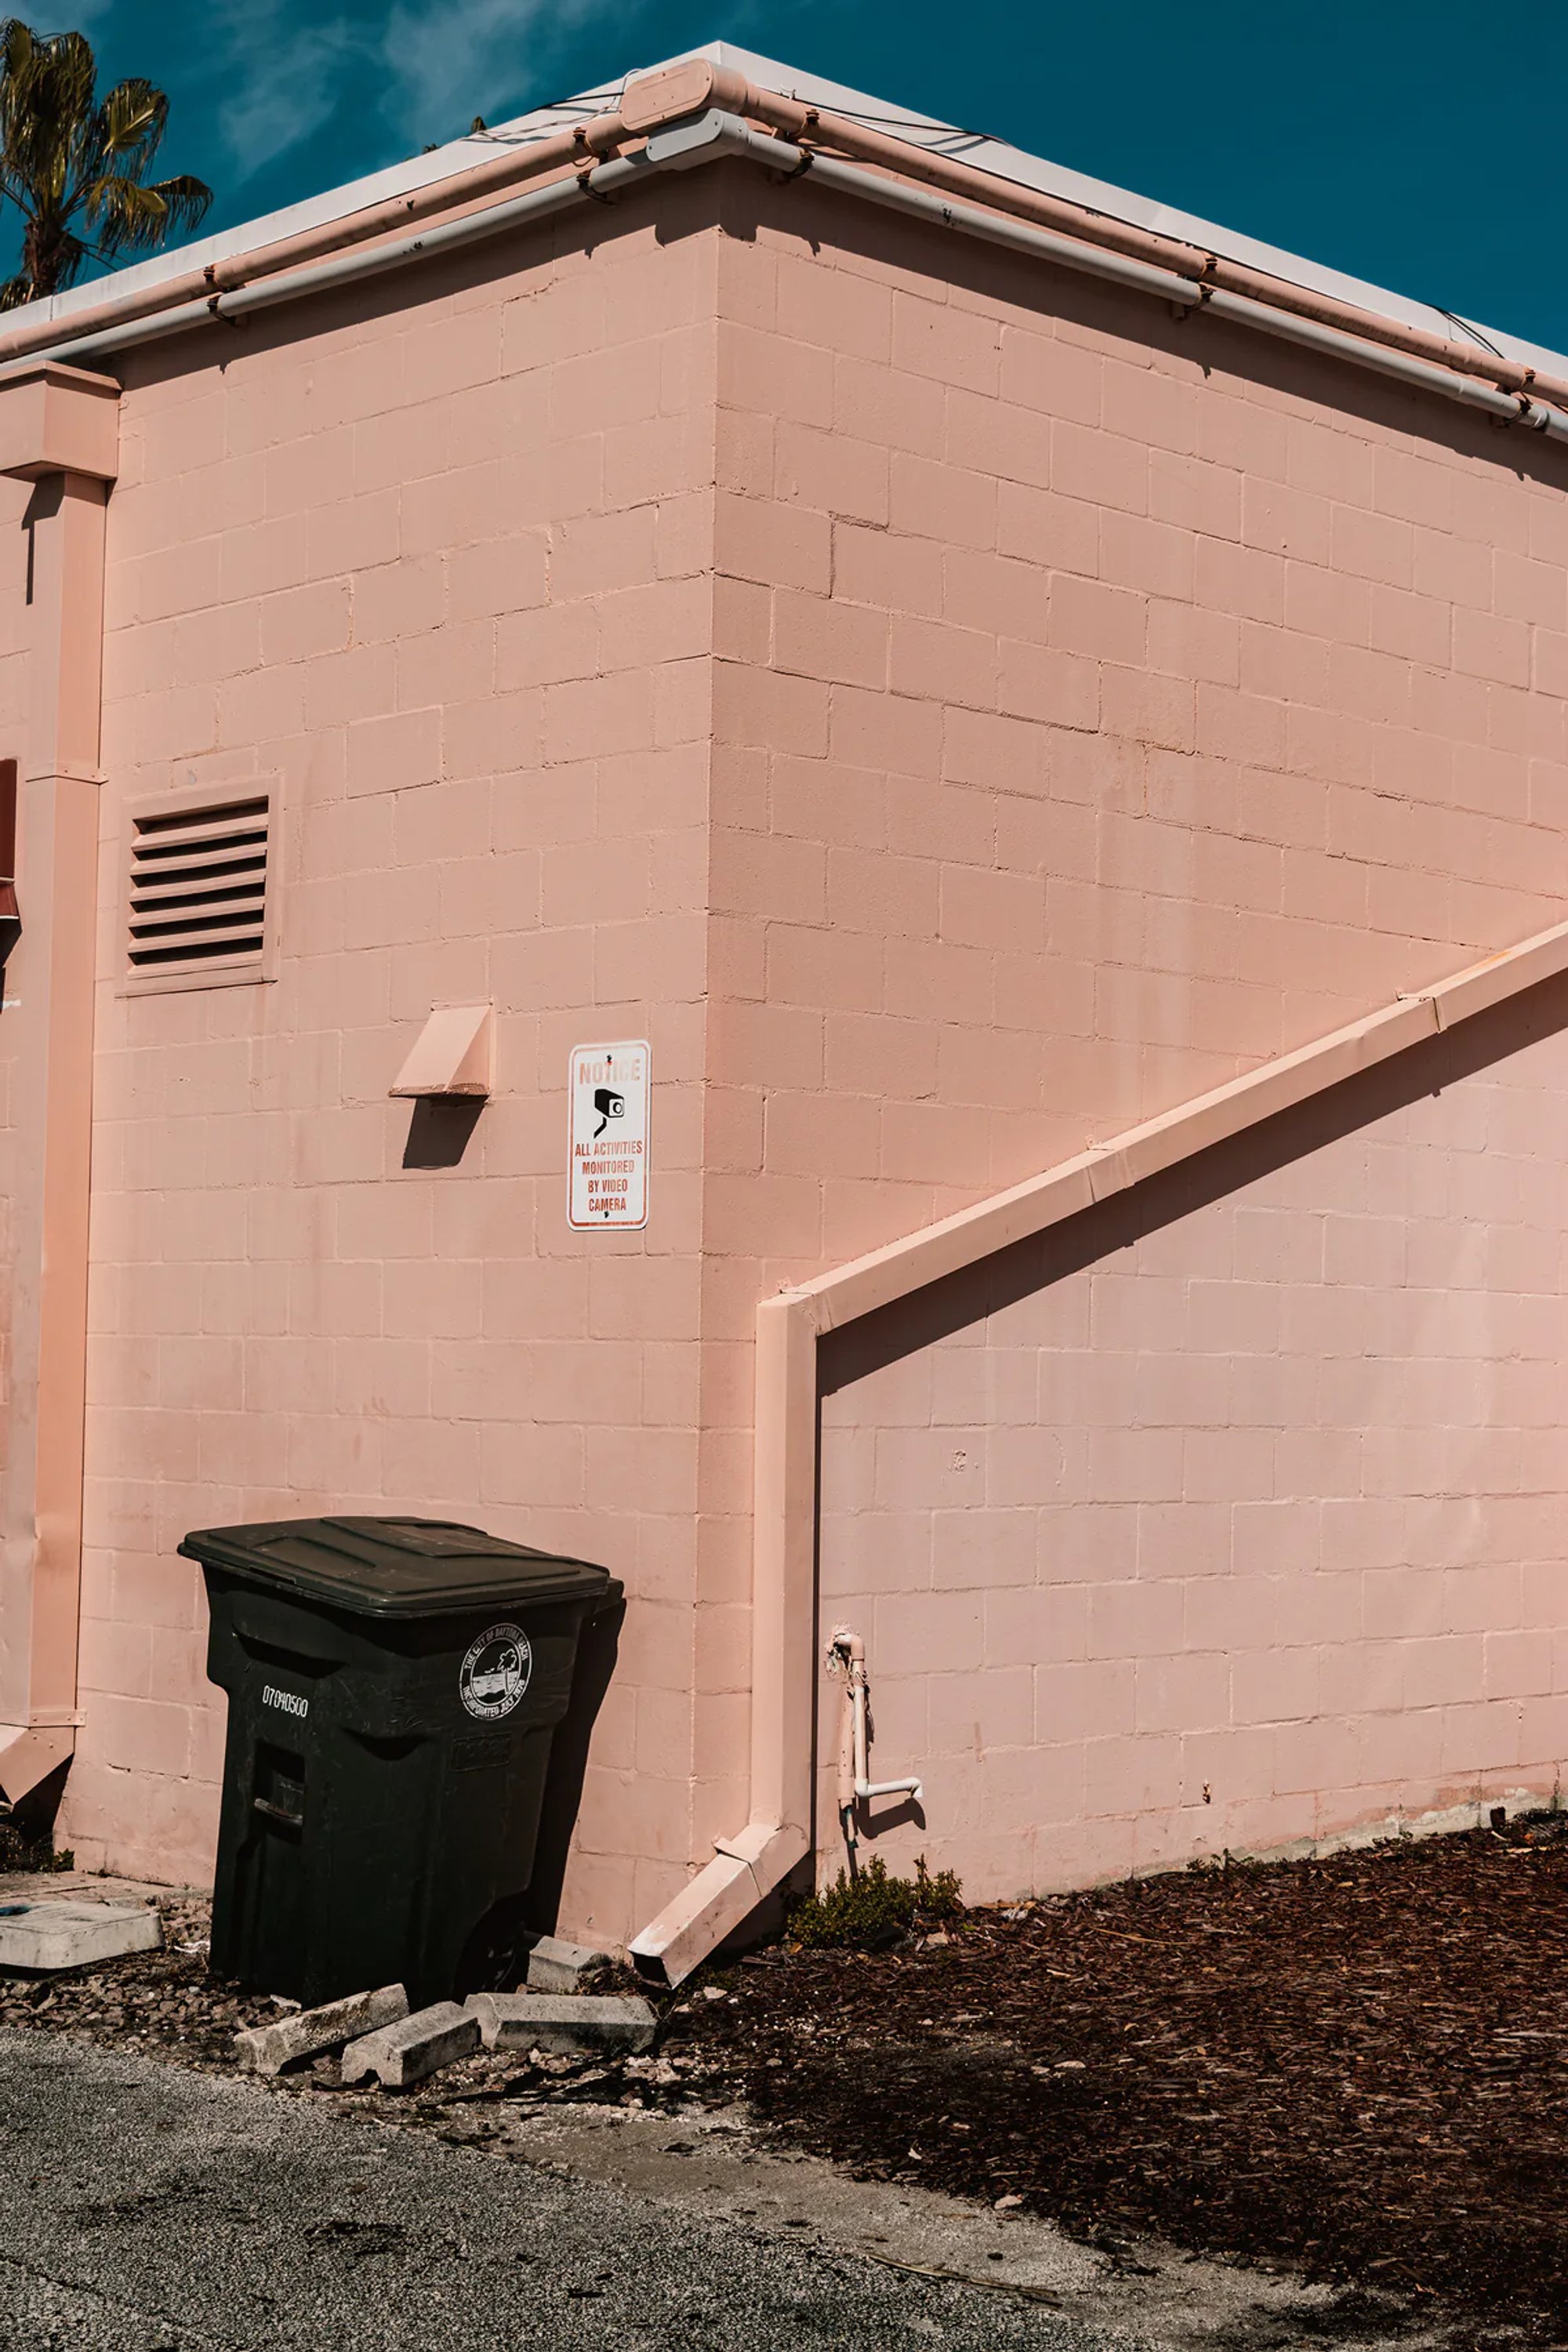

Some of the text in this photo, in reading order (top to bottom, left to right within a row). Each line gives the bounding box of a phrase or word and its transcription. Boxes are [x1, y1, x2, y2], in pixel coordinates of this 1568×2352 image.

[579, 1058, 641, 1084] NOTICE
[575, 1140, 643, 1156] ALL ACTIVITIES
[582, 1160, 635, 1175] MONITORED
[588, 1178, 628, 1193] BY VIDEO
[589, 1197, 626, 1212] CAMERA
